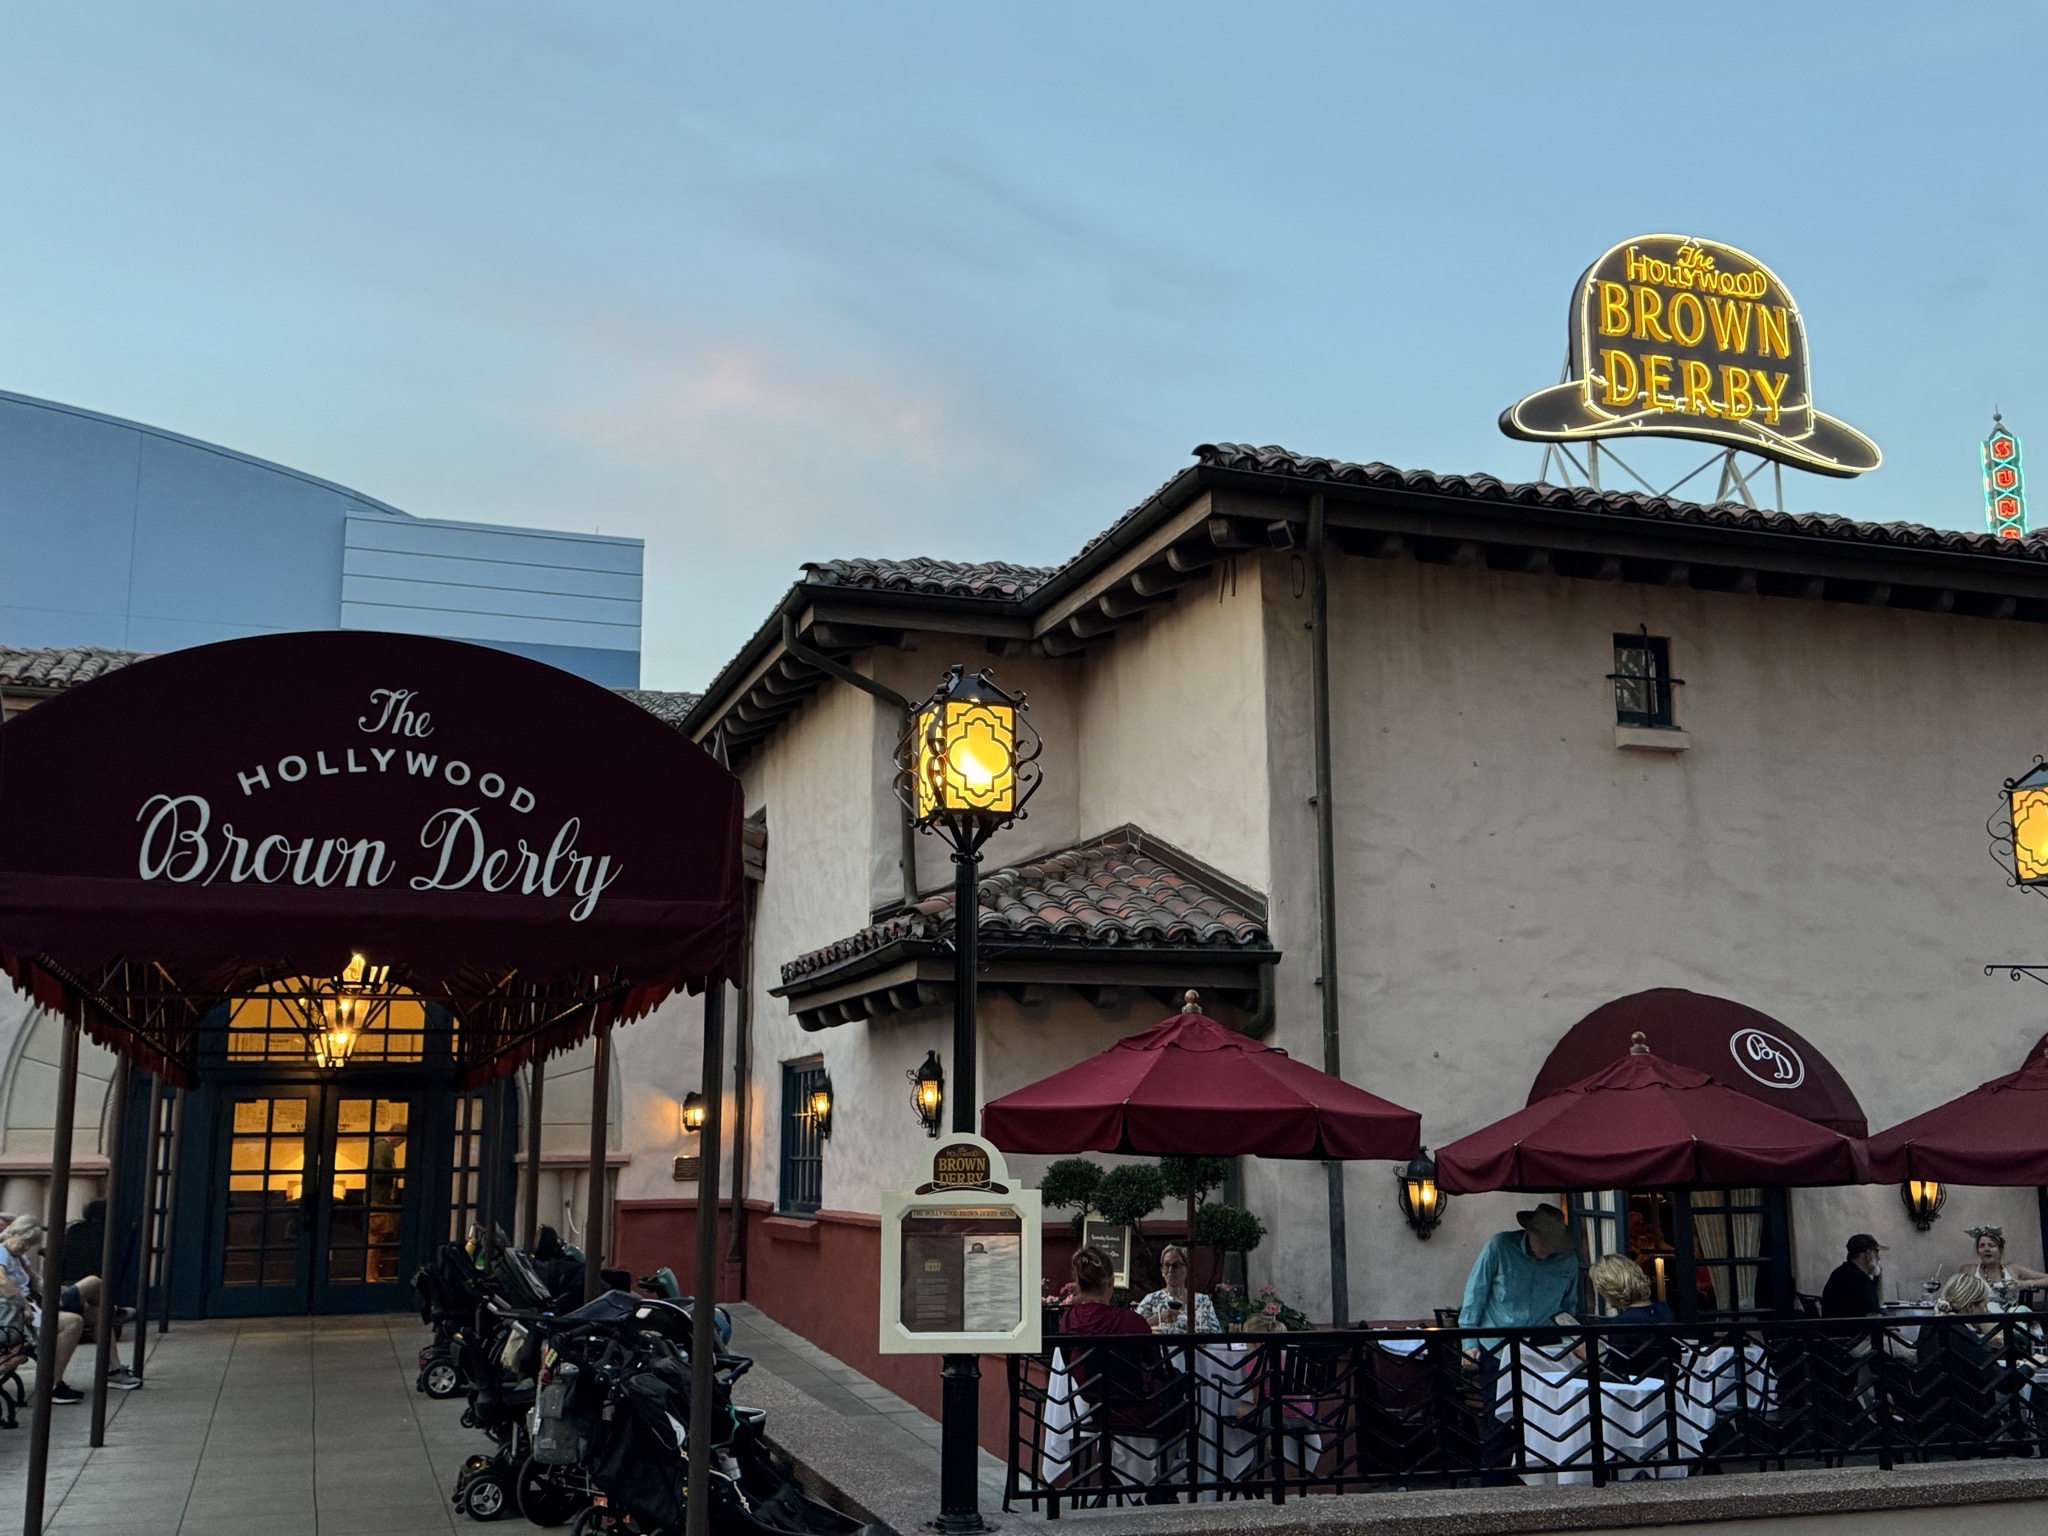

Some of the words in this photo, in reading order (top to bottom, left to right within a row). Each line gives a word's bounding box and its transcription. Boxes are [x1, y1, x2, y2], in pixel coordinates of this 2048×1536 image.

[1625, 246, 1768, 299] HOLLYWOOD
[1677, 245, 1715, 271] The
[1597, 280, 1788, 360] BROWN
[1600, 349, 1790, 425] DERBY
[358, 688, 434, 738] The
[237, 748, 537, 814] HOLLYWOOD
[136, 794, 396, 887] Brown
[409, 807, 623, 922] Derby
[938, 1157, 986, 1171] BROWN
[939, 1172, 984, 1186] DERBY
